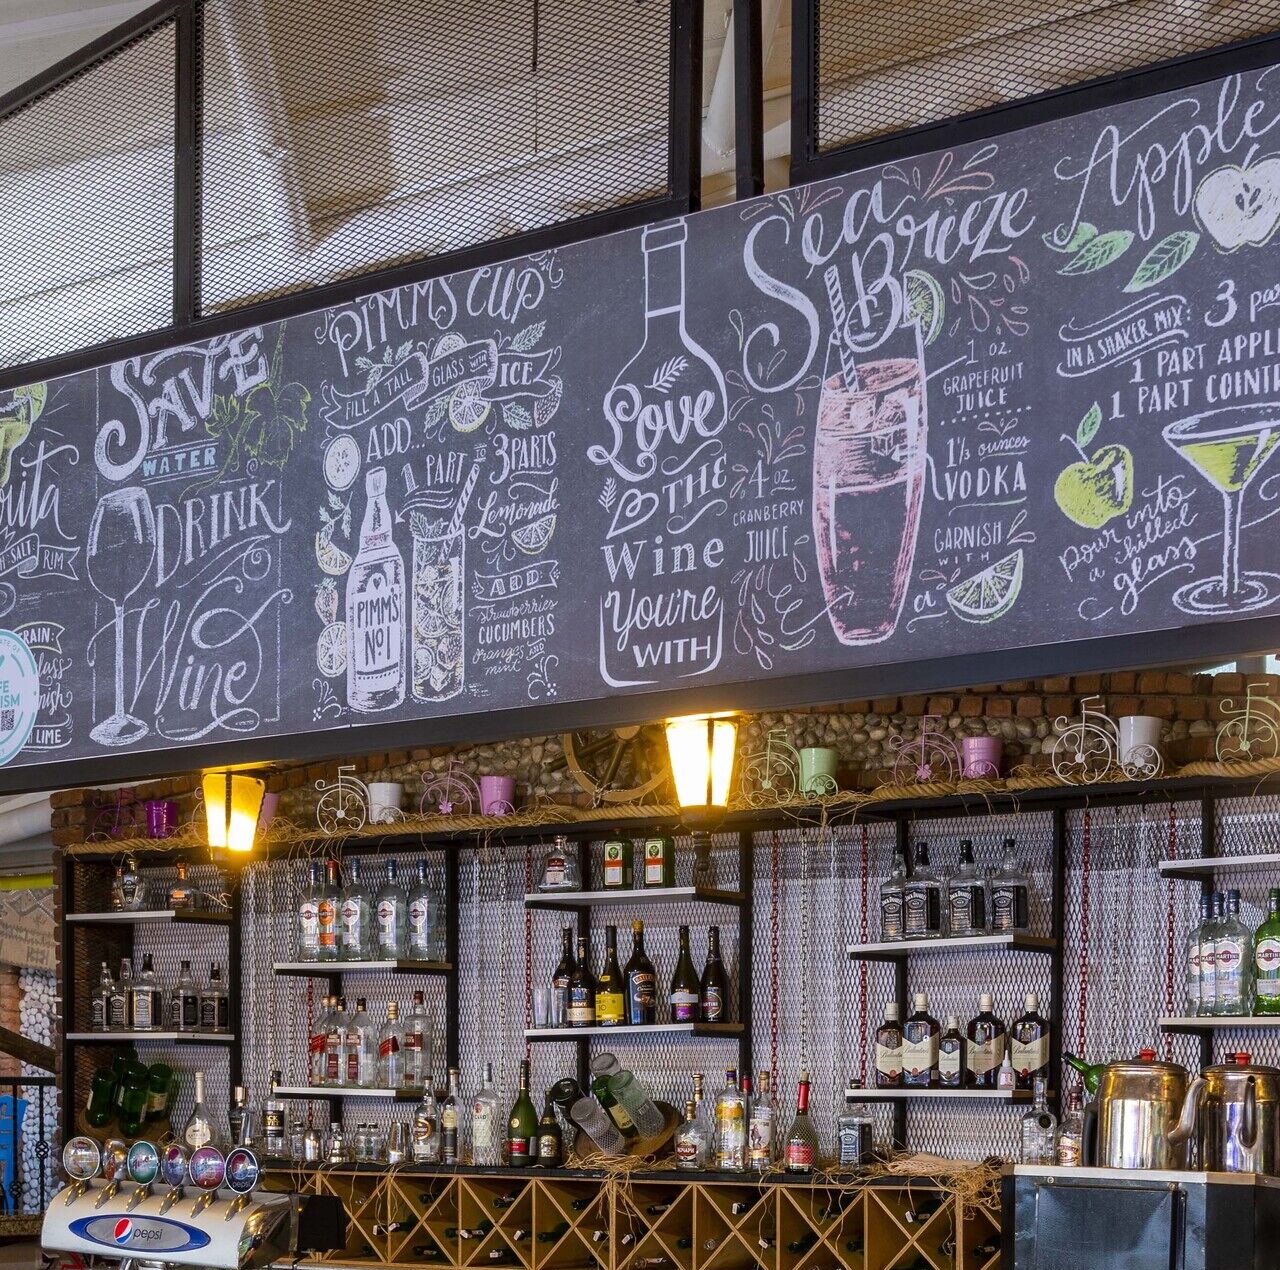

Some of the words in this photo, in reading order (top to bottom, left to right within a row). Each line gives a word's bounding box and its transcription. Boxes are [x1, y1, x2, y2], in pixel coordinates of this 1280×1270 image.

[743, 181, 916, 393] Sea
[843, 187, 1037, 353] Breeze
[467, 266, 545, 325] CUP
[1205, 279, 1239, 328] 3
[1097, 320, 1152, 359] SHAKER
[1157, 343, 1208, 377] PART
[346, 398, 369, 420] FILL
[384, 367, 413, 396] TALL
[432, 359, 466, 388] GLASS
[499, 361, 534, 388] ICE
[943, 363, 1025, 394] GRAPEFRUIT
[1138, 378, 1192, 414] PART
[94, 326, 271, 481] SAVE
[957, 388, 1009, 414] JUICE
[586, 382, 728, 481] Love
[977, 435, 1031, 460] ounces
[142, 447, 217, 477] WATER
[426, 451, 468, 487] PART
[511, 431, 557, 470] PARTS
[662, 453, 727, 514] THE
[943, 462, 1028, 502] VODKA
[468, 478, 560, 538] Lemonade
[733, 499, 805, 527] CRANBERRY
[155, 479, 292, 588] DRINK
[743, 525, 792, 564] JUICE
[934, 523, 1002, 553] GARNISH
[11, 542, 33, 565] SALT
[43, 549, 65, 570] RIM
[600, 535, 724, 583] Wine
[938, 551, 991, 567] WITH
[478, 613, 555, 645] CUCUMBERS
[632, 635, 711, 668] WITH
[36, 729, 62, 745] LIME
[1216, 952, 1239, 960] MARTINI
[1257, 951, 1280, 959] MARTINI
[133, 1228, 163, 1242] pepsi
